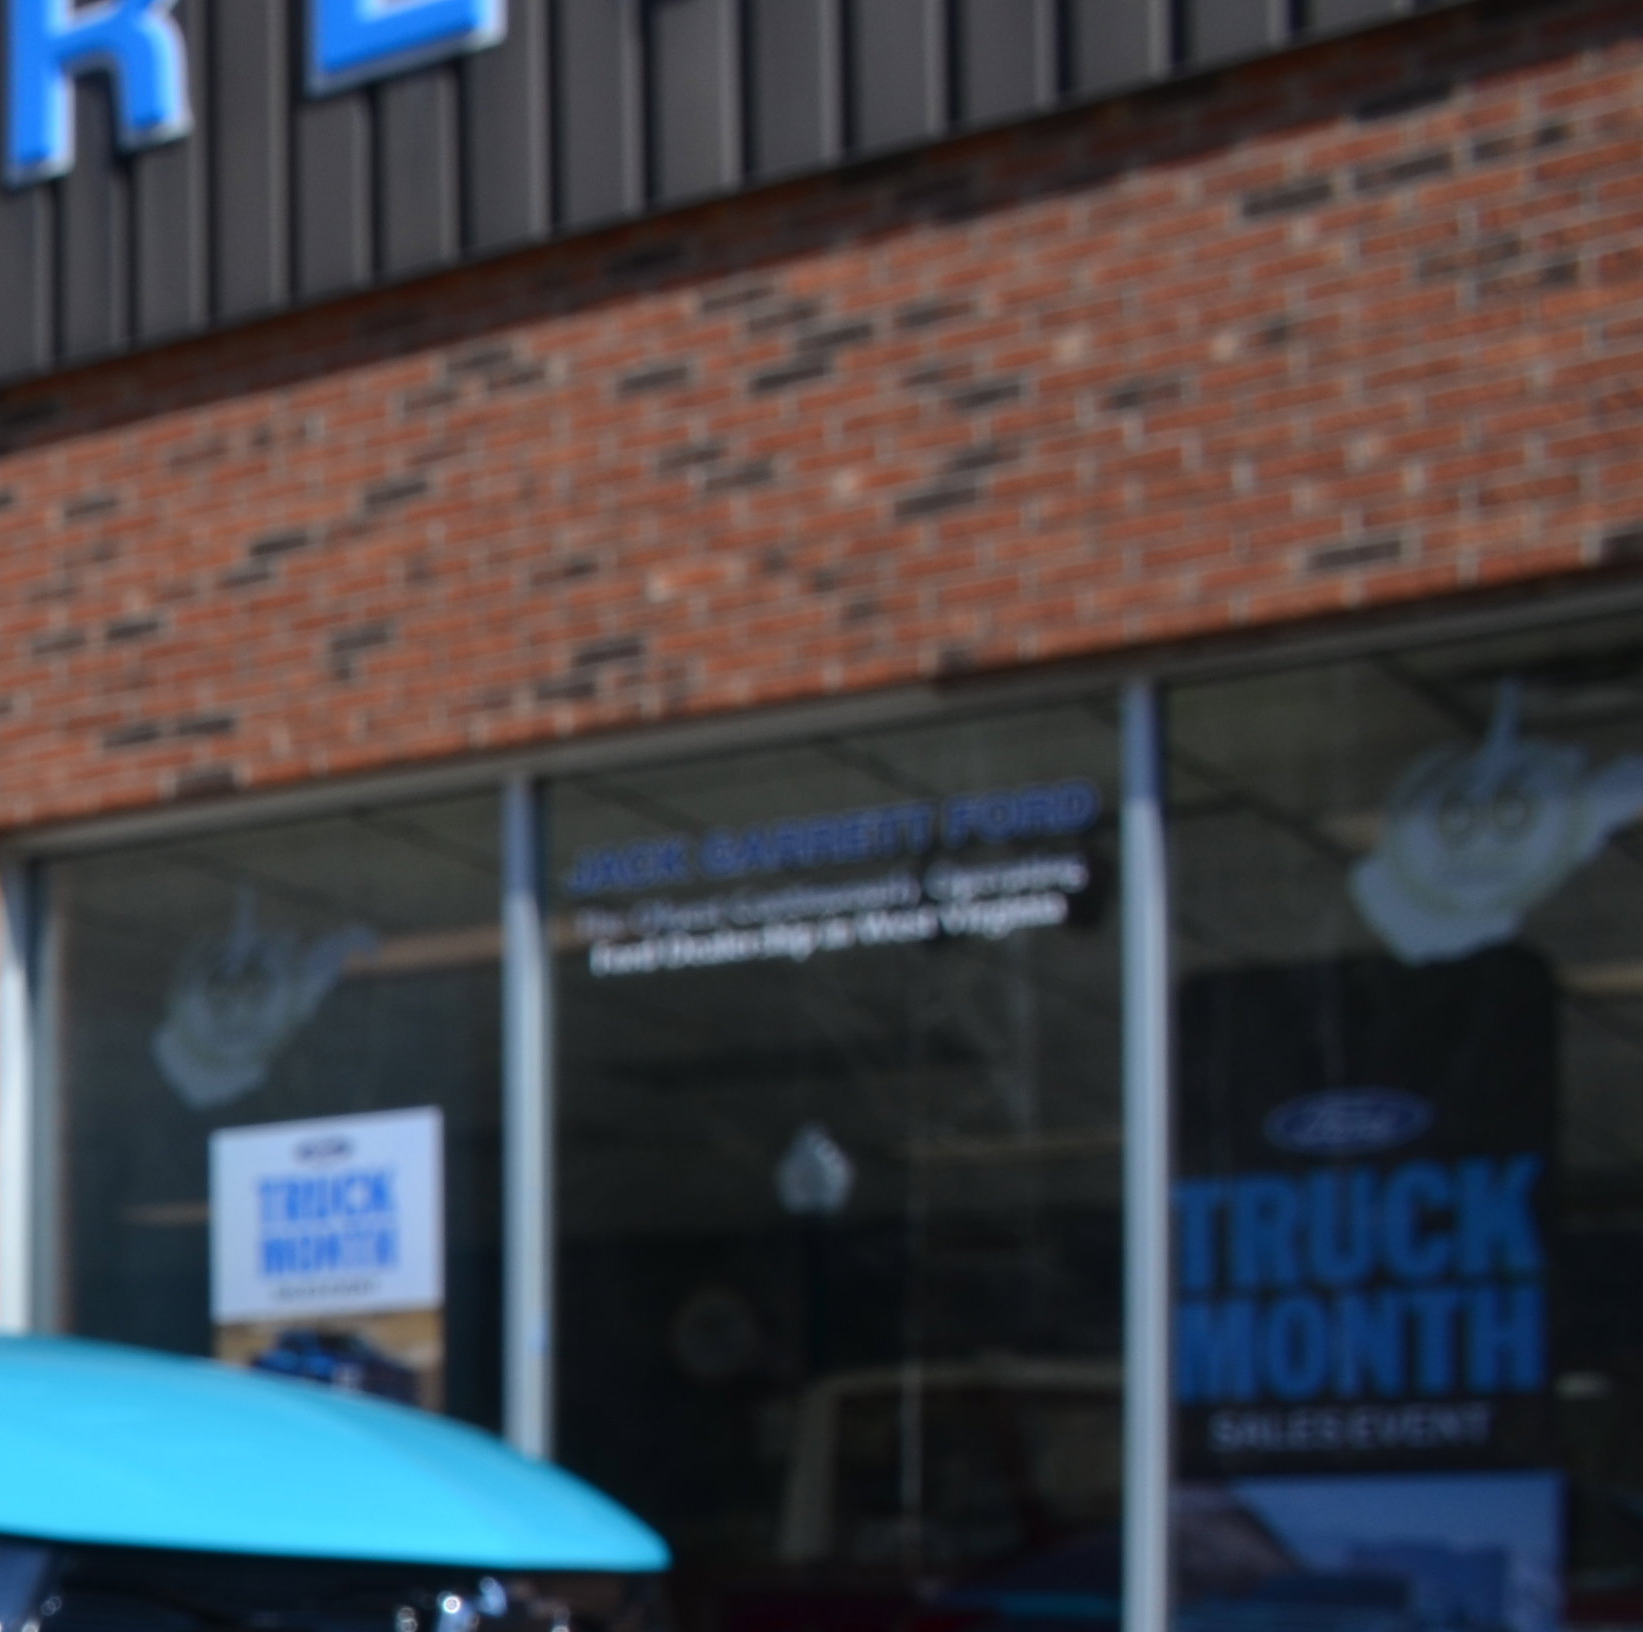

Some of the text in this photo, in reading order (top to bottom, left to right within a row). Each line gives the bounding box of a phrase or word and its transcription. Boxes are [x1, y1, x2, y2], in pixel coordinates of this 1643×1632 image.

[566, 782, 1099, 893] JACK GARRETT FORD
[255, 1168, 397, 1228] TRUCK
[1170, 1153, 1543, 1290] TRUCK
[257, 1224, 397, 1280] MONTH
[1174, 1286, 1545, 1401] MONTH
[1212, 1405, 1493, 1450] SALES EVENT
